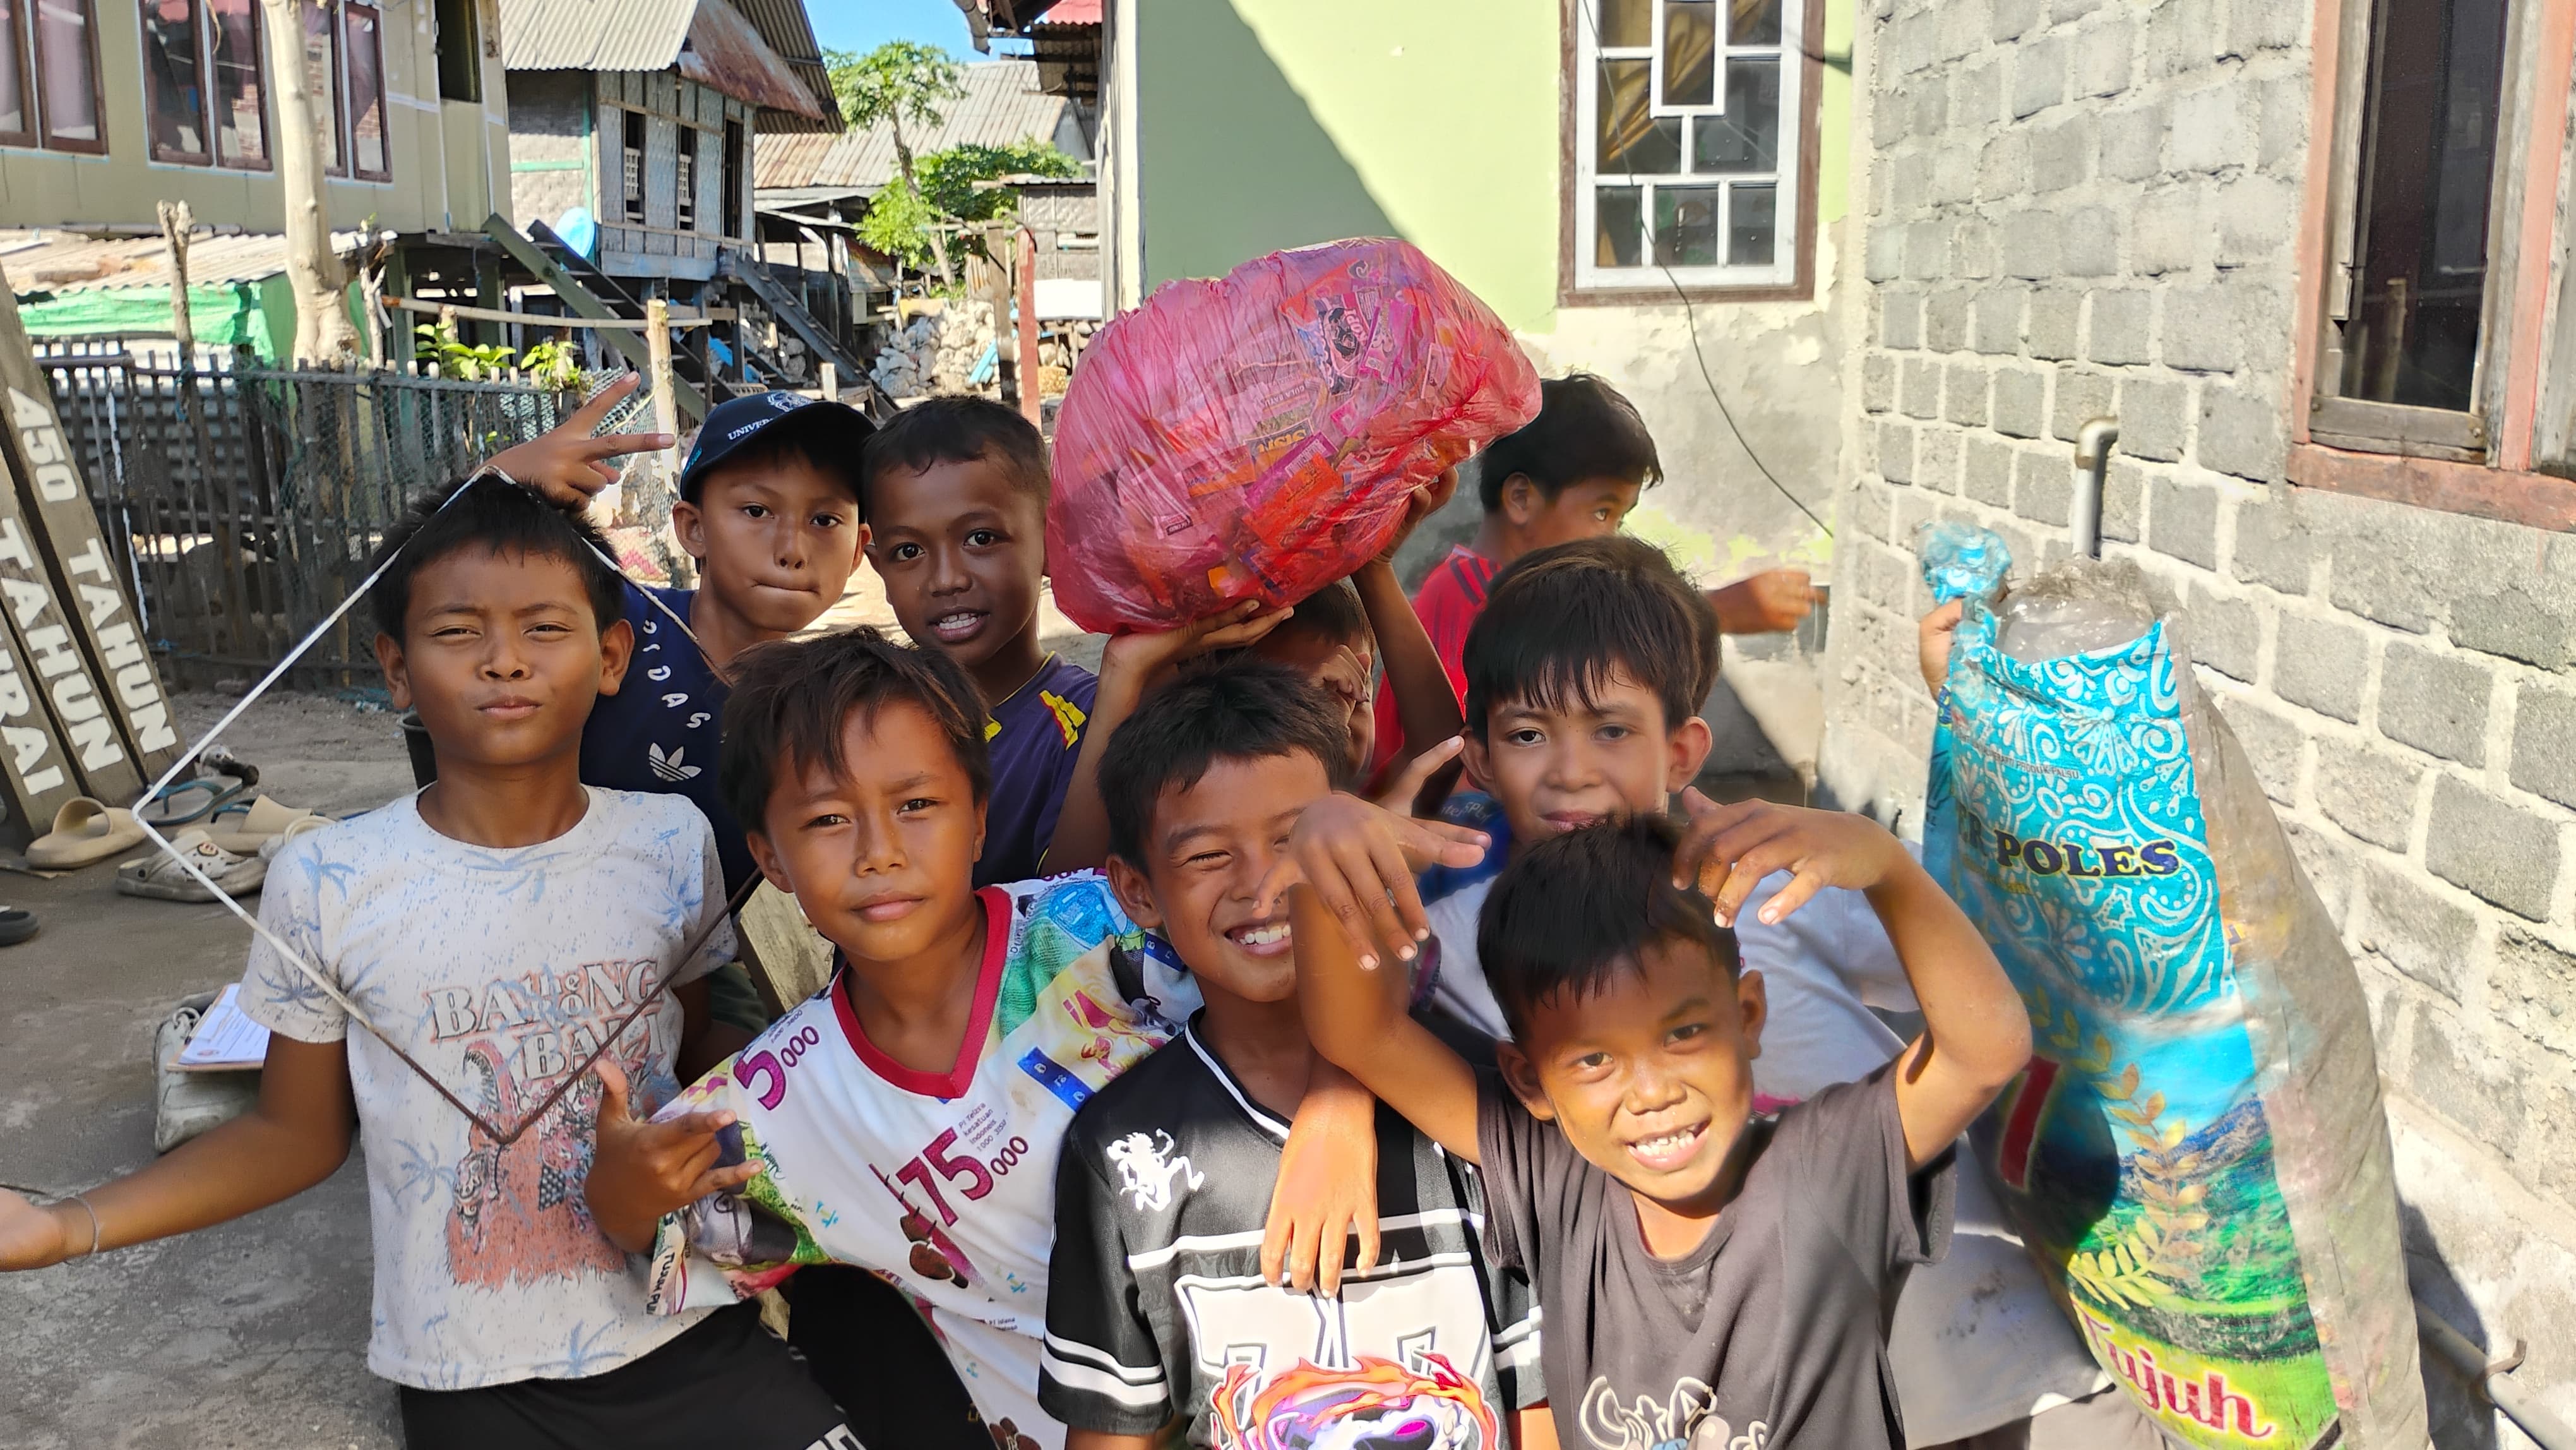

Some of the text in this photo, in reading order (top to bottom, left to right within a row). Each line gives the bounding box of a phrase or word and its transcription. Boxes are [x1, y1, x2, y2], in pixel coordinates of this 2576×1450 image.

[8, 386, 178, 754] 450 TAHUN
[0, 517, 124, 772] TAHUN
[2016, 760, 2051, 775] PRODUK
[1994, 829, 2181, 878] POLES
[2070, 1299, 2276, 1438] Tujuh
